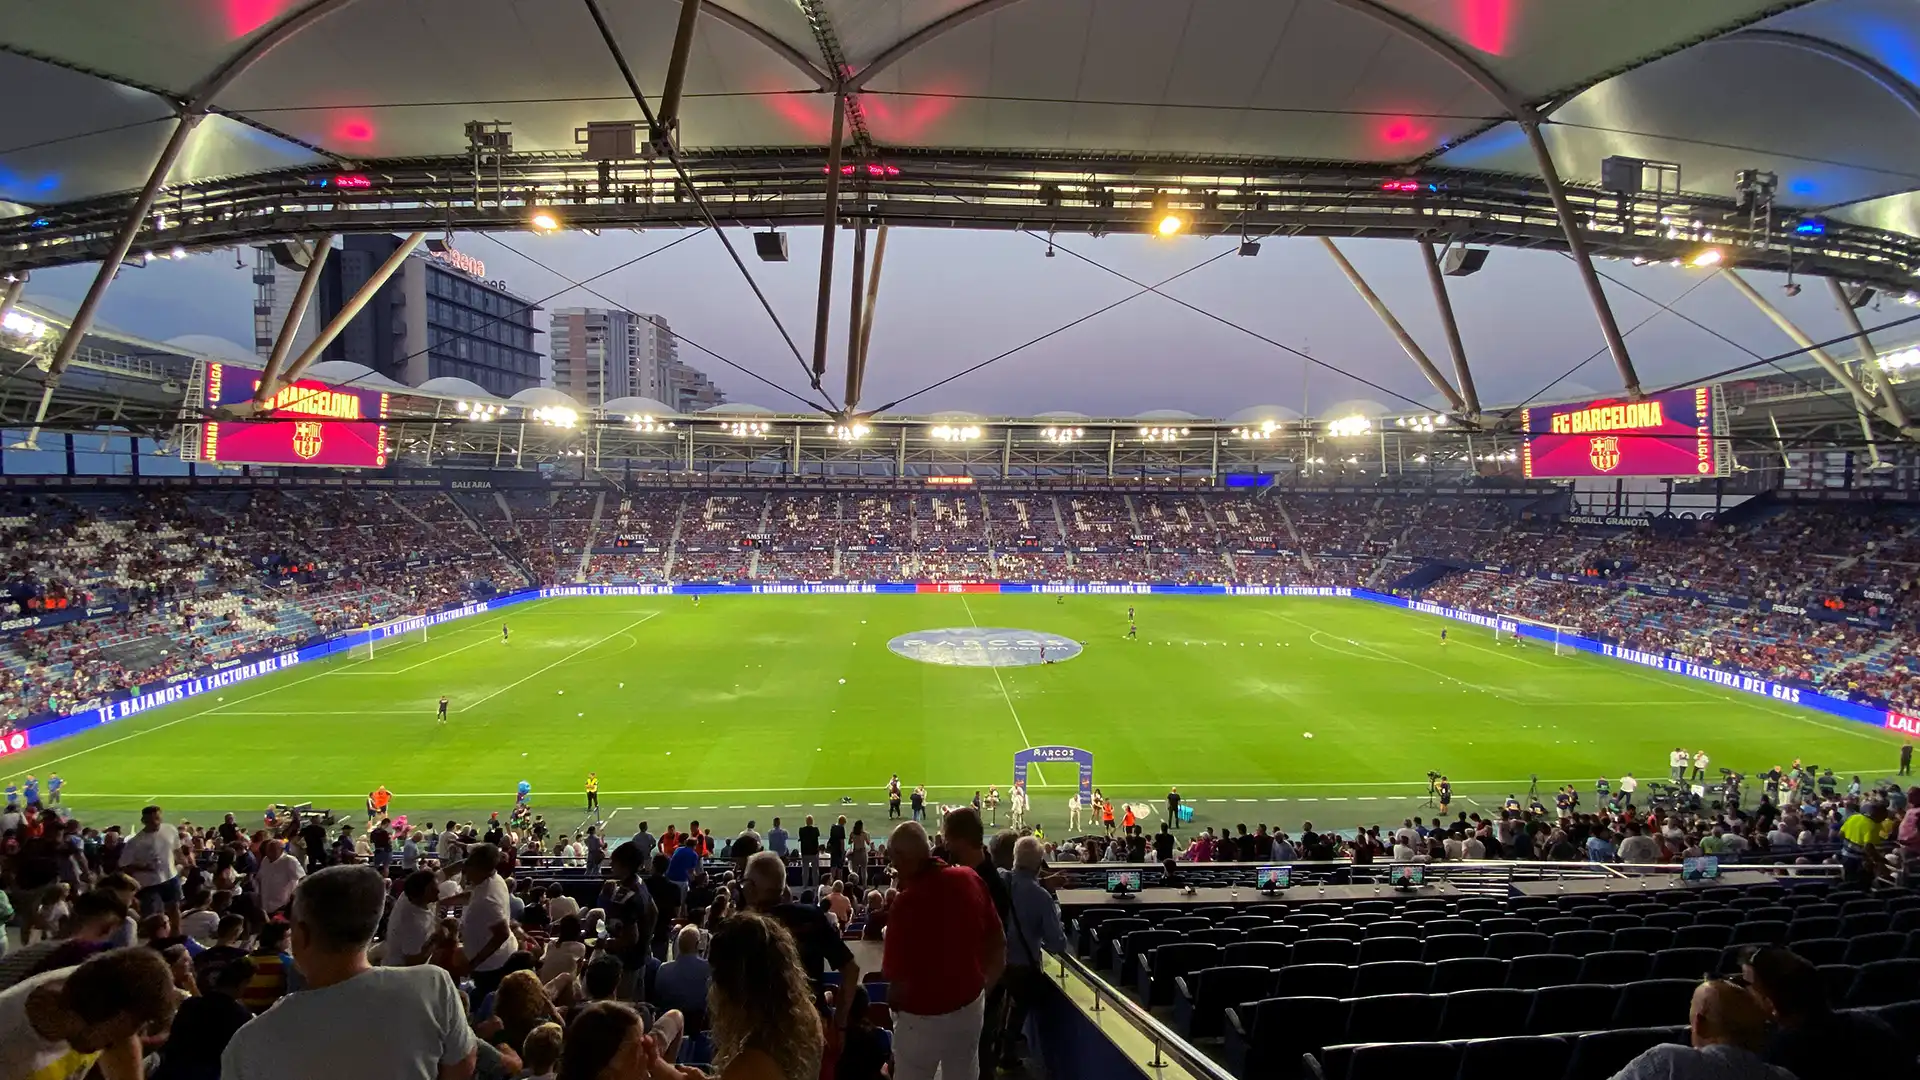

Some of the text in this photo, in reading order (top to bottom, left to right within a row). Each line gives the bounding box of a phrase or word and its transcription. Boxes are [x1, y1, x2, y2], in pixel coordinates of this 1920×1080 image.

[210, 363, 222, 401] LALIGA
[277, 387, 358, 419] BARCELONA
[1552, 402, 1662, 434] FC BARCELONA
[207, 422, 218, 461] JORNAD
[1569, 516, 1650, 527] ORGULL GRANOTA
[539, 585, 674, 598] TE BAJAMOS LA FACTURA DEL GAS
[751, 584, 877, 593] TE BAJAMOS LA FACTURA DEL GAS
[1031, 585, 1152, 594] TE BAJAMOS LA FACTURA DEL GAS
[1225, 586, 1352, 597] TE BAJAMOS LA FACTURA DEL GAS
[1408, 600, 1416, 609] TE
[1416, 601, 1444, 616] BAJAMOS
[1445, 608, 1454, 617] LA
[1455, 610, 1485, 626] FACTURA
[1501, 620, 1517, 632] GAS
[1772, 604, 1799, 614] asisa
[1, 618, 32, 630] asisa
[382, 626, 392, 637] TE
[426, 615, 434, 625] LA
[436, 608, 464, 623] FACTURA
[464, 604, 475, 615] DEL
[476, 602, 488, 611] GAS
[1602, 643, 1613, 656] TE
[1616, 647, 1664, 668] BAJAMOS
[1668, 658, 1681, 673] LA
[1686, 663, 1740, 688] FACTURA
[1744, 677, 1767, 695] DEL
[1772, 684, 1800, 702] GAS
[98, 652, 299, 723] TE BAJAMOS LA FACTURA DEL GAS
[1889, 715, 1920, 734] LALI
[1033, 748, 1074, 757] MARCOS
